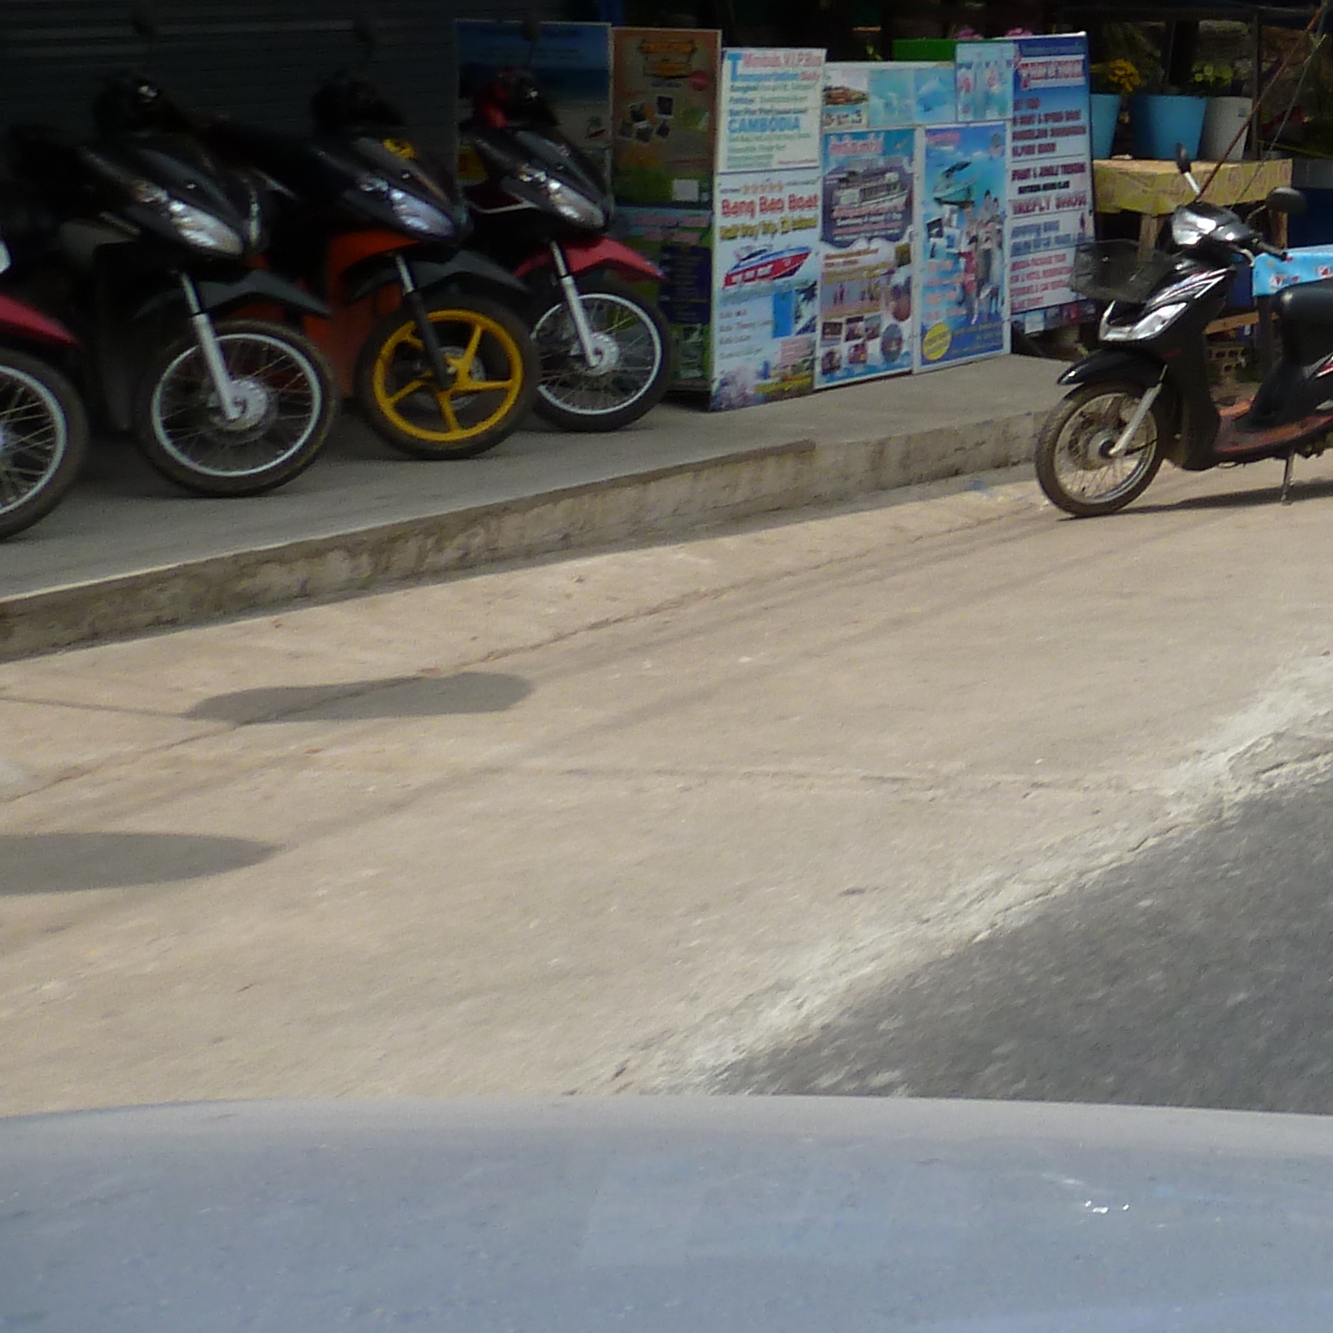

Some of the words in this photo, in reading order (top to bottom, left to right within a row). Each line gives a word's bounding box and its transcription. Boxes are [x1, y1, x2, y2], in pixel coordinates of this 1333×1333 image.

[728, 116, 800, 133] CAMBODIA
[722, 198, 756, 218] Bang
[759, 196, 784, 214] Bao
[788, 193, 818, 212] Boat
